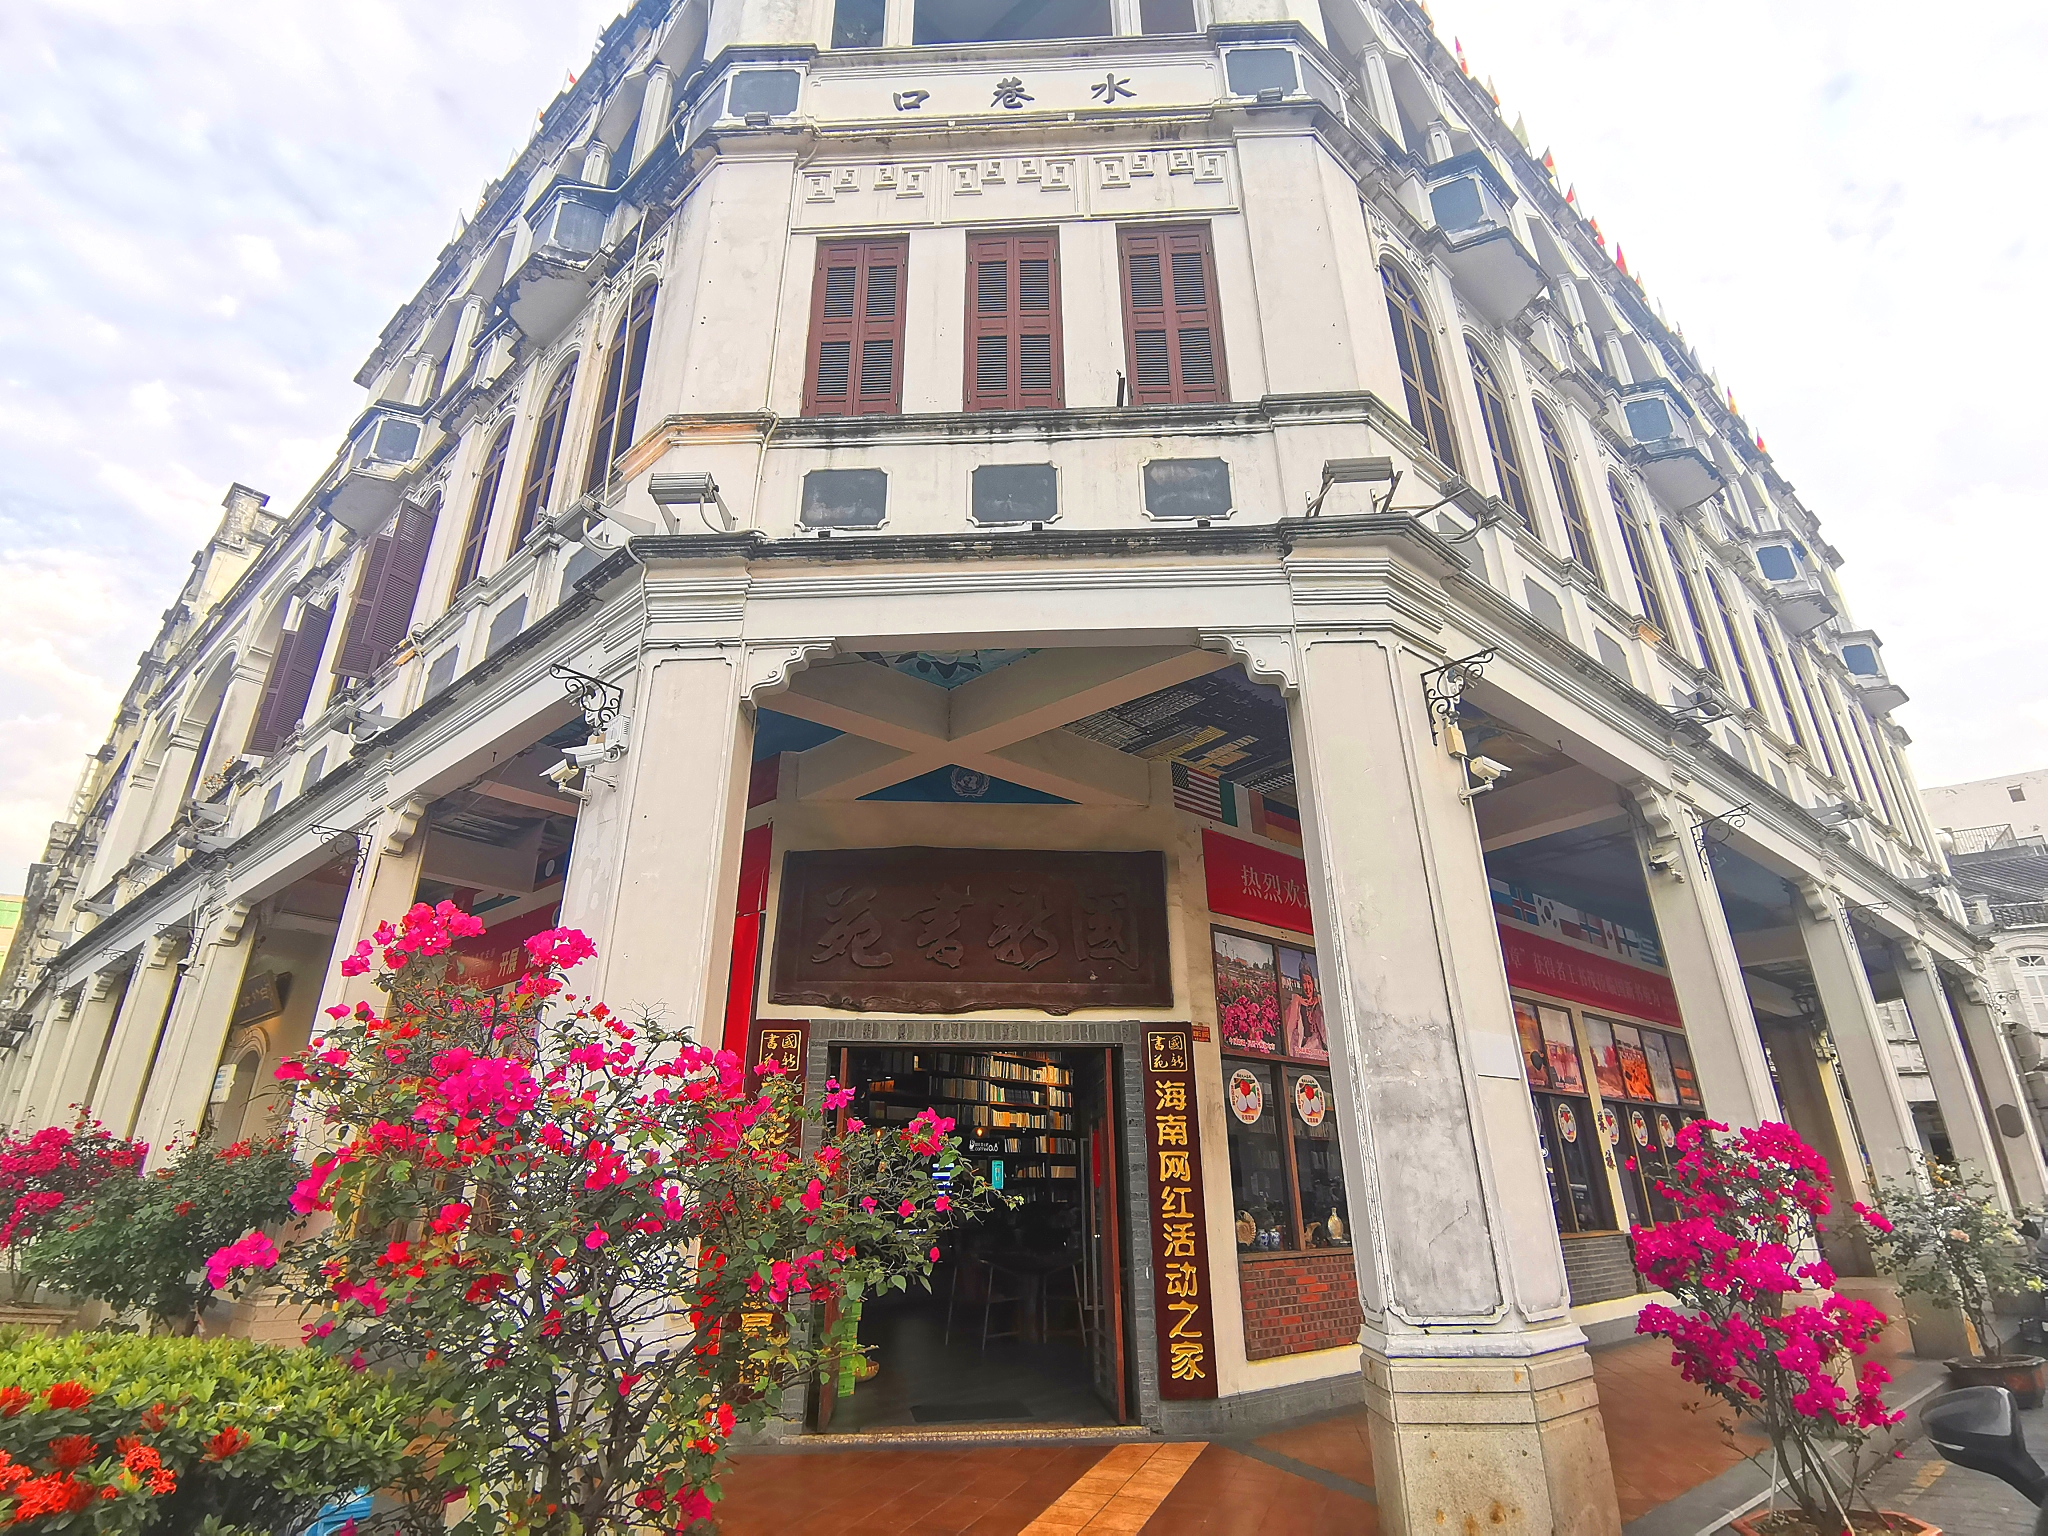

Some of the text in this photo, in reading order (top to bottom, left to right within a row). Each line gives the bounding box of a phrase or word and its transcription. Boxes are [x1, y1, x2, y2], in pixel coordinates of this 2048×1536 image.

[1155, 1080, 1206, 1381] 海南网红活动之家
